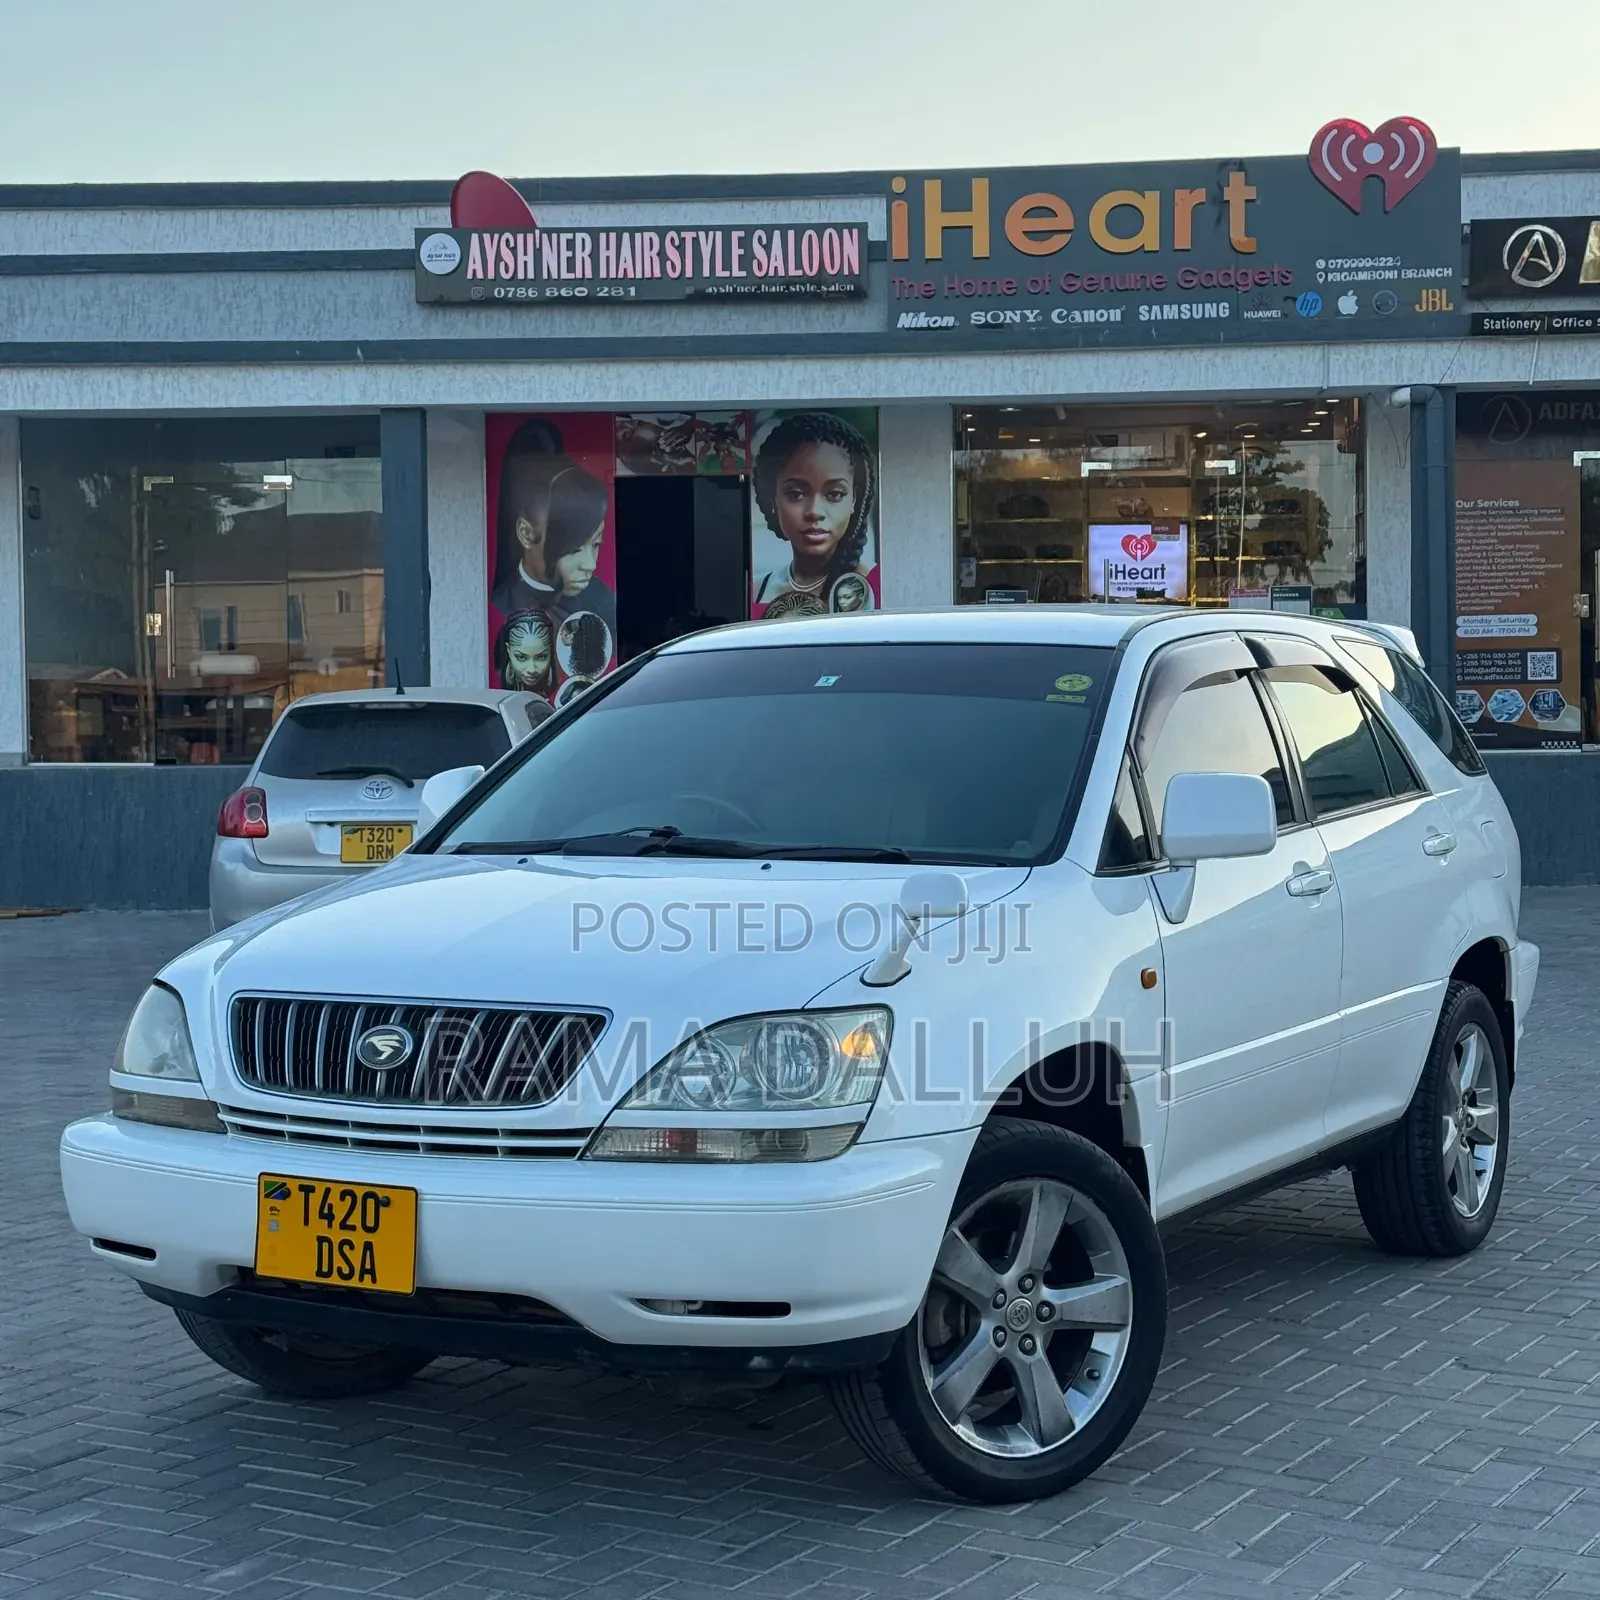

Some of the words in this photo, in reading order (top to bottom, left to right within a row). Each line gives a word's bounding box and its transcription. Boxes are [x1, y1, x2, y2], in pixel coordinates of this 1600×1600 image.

[891, 171, 1257, 260] iHeart
[466, 230, 593, 280] AYSH'NER
[599, 231, 661, 279] HAIR
[665, 230, 746, 278] STYLE
[752, 227, 860, 277] SALOON
[892, 275, 936, 299] The
[943, 273, 1018, 298] Home
[1026, 272, 1052, 296] of
[1059, 270, 1168, 294] Genuine
[1177, 263, 1294, 293] Gadgets
[1327, 269, 1398, 282] KIGAMBONI
[1401, 267, 1453, 279] BRANCH
[493, 286, 538, 298] 0786
[545, 286, 589, 297] 860
[596, 286, 636, 297] 281
[1415, 288, 1454, 312] JBL
[896, 311, 955, 328] Nikon
[970, 309, 1038, 325] SONY
[1050, 307, 1122, 324] Canon
[1138, 301, 1230, 322] SAMSUNG
[1243, 309, 1282, 319] HUAWEI
[1483, 317, 1541, 332] Stationery
[1552, 317, 1593, 328] Office
[1455, 500, 1474, 508] Our
[1477, 498, 1520, 508] Services
[1109, 563, 1167, 580] iHeart
[1498, 616, 1531, 625] Saturday
[358, 827, 395, 843] T320
[366, 844, 394, 860] DRM
[298, 1184, 381, 1234] T420
[315, 1235, 377, 1284] DSA
